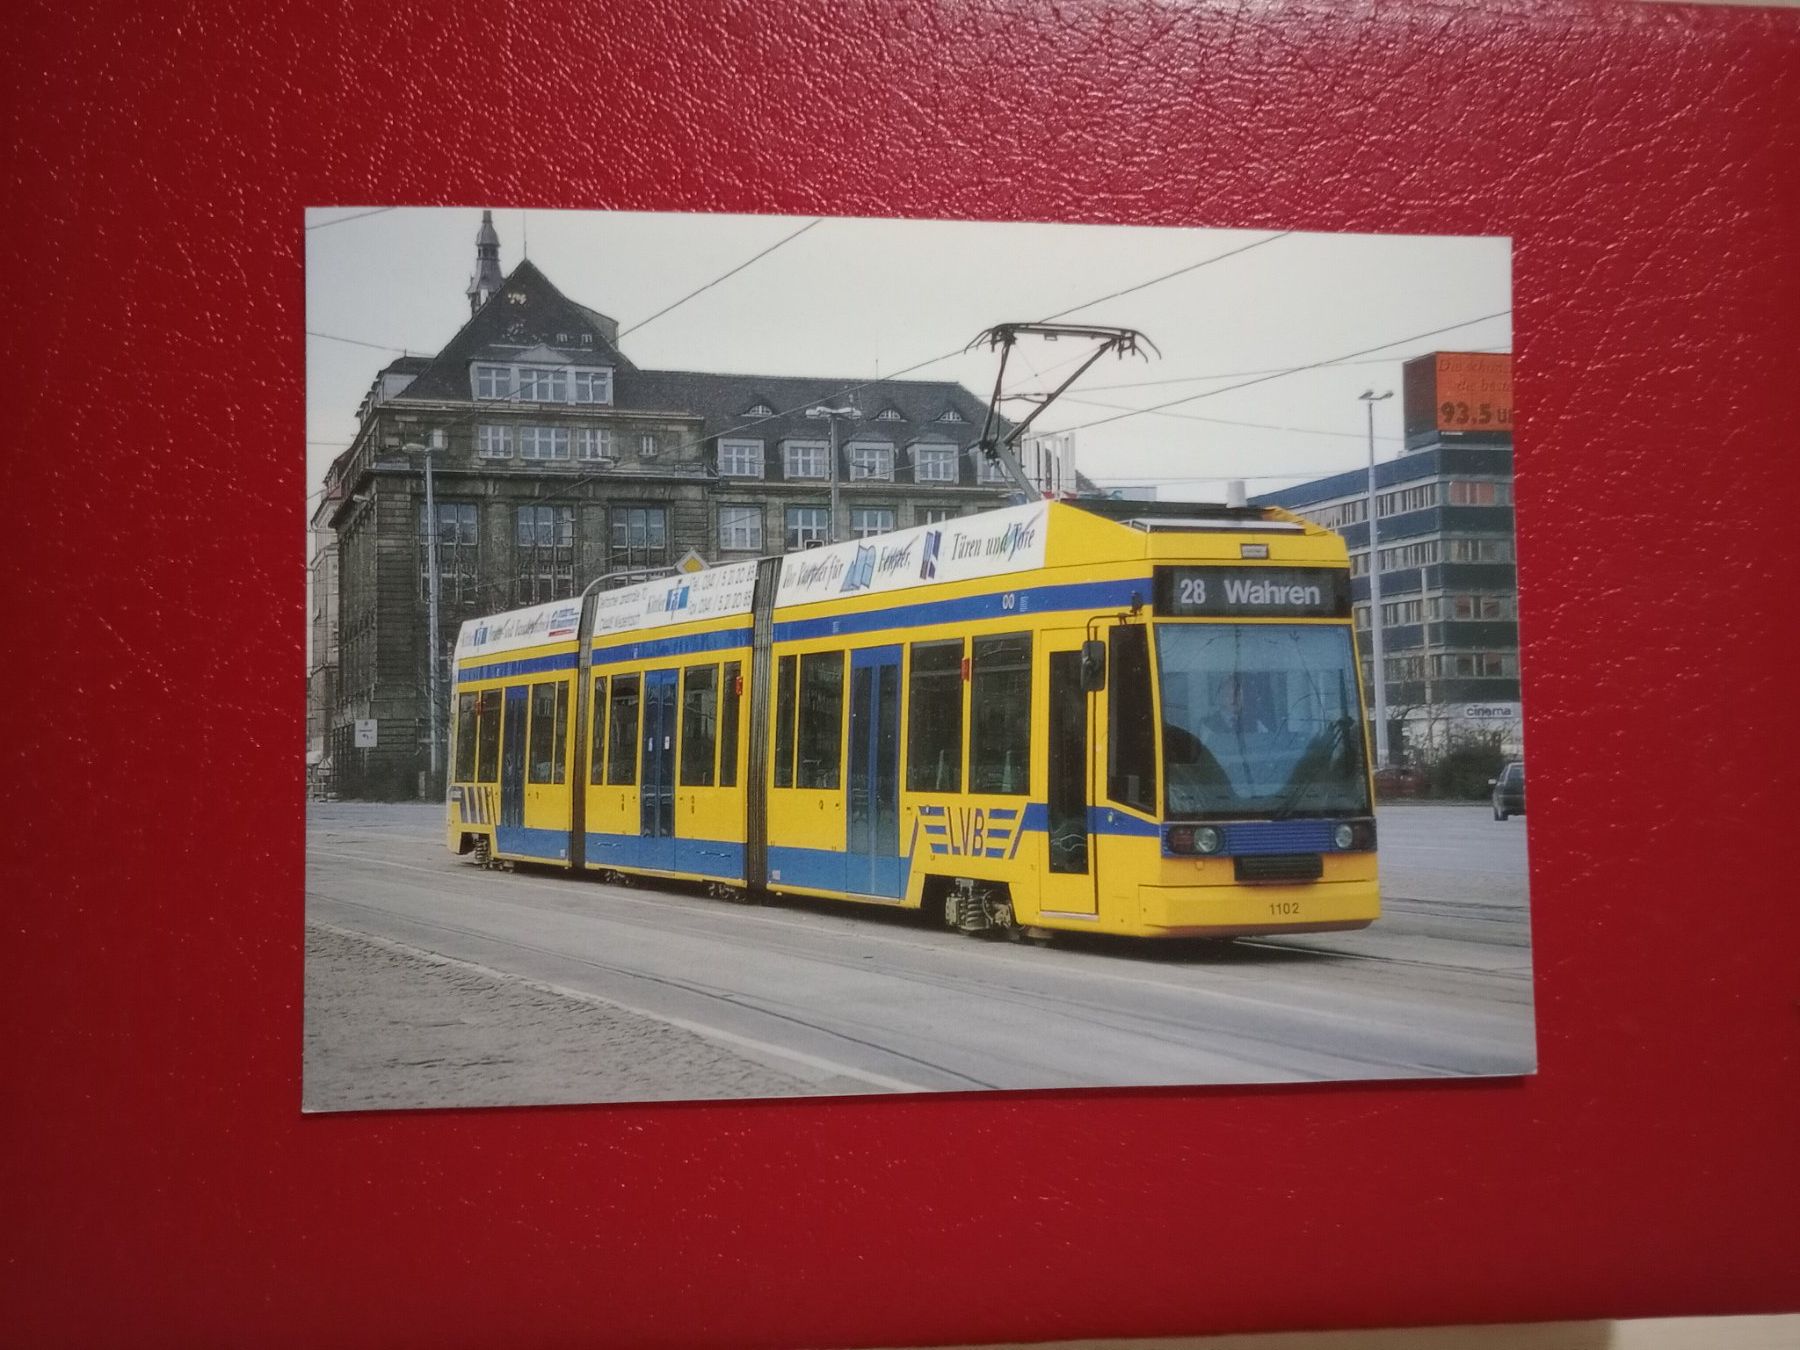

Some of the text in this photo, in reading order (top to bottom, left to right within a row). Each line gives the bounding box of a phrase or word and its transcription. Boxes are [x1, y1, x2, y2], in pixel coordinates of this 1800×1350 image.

[1441, 401, 1492, 425] 93.5
[952, 532, 982, 561] Türen
[986, 522, 1011, 558] und
[1180, 578, 1321, 605] 28 Wahren
[1466, 704, 1512, 717] cinema
[946, 806, 985, 857] LVB
[1269, 902, 1300, 915] 1102
